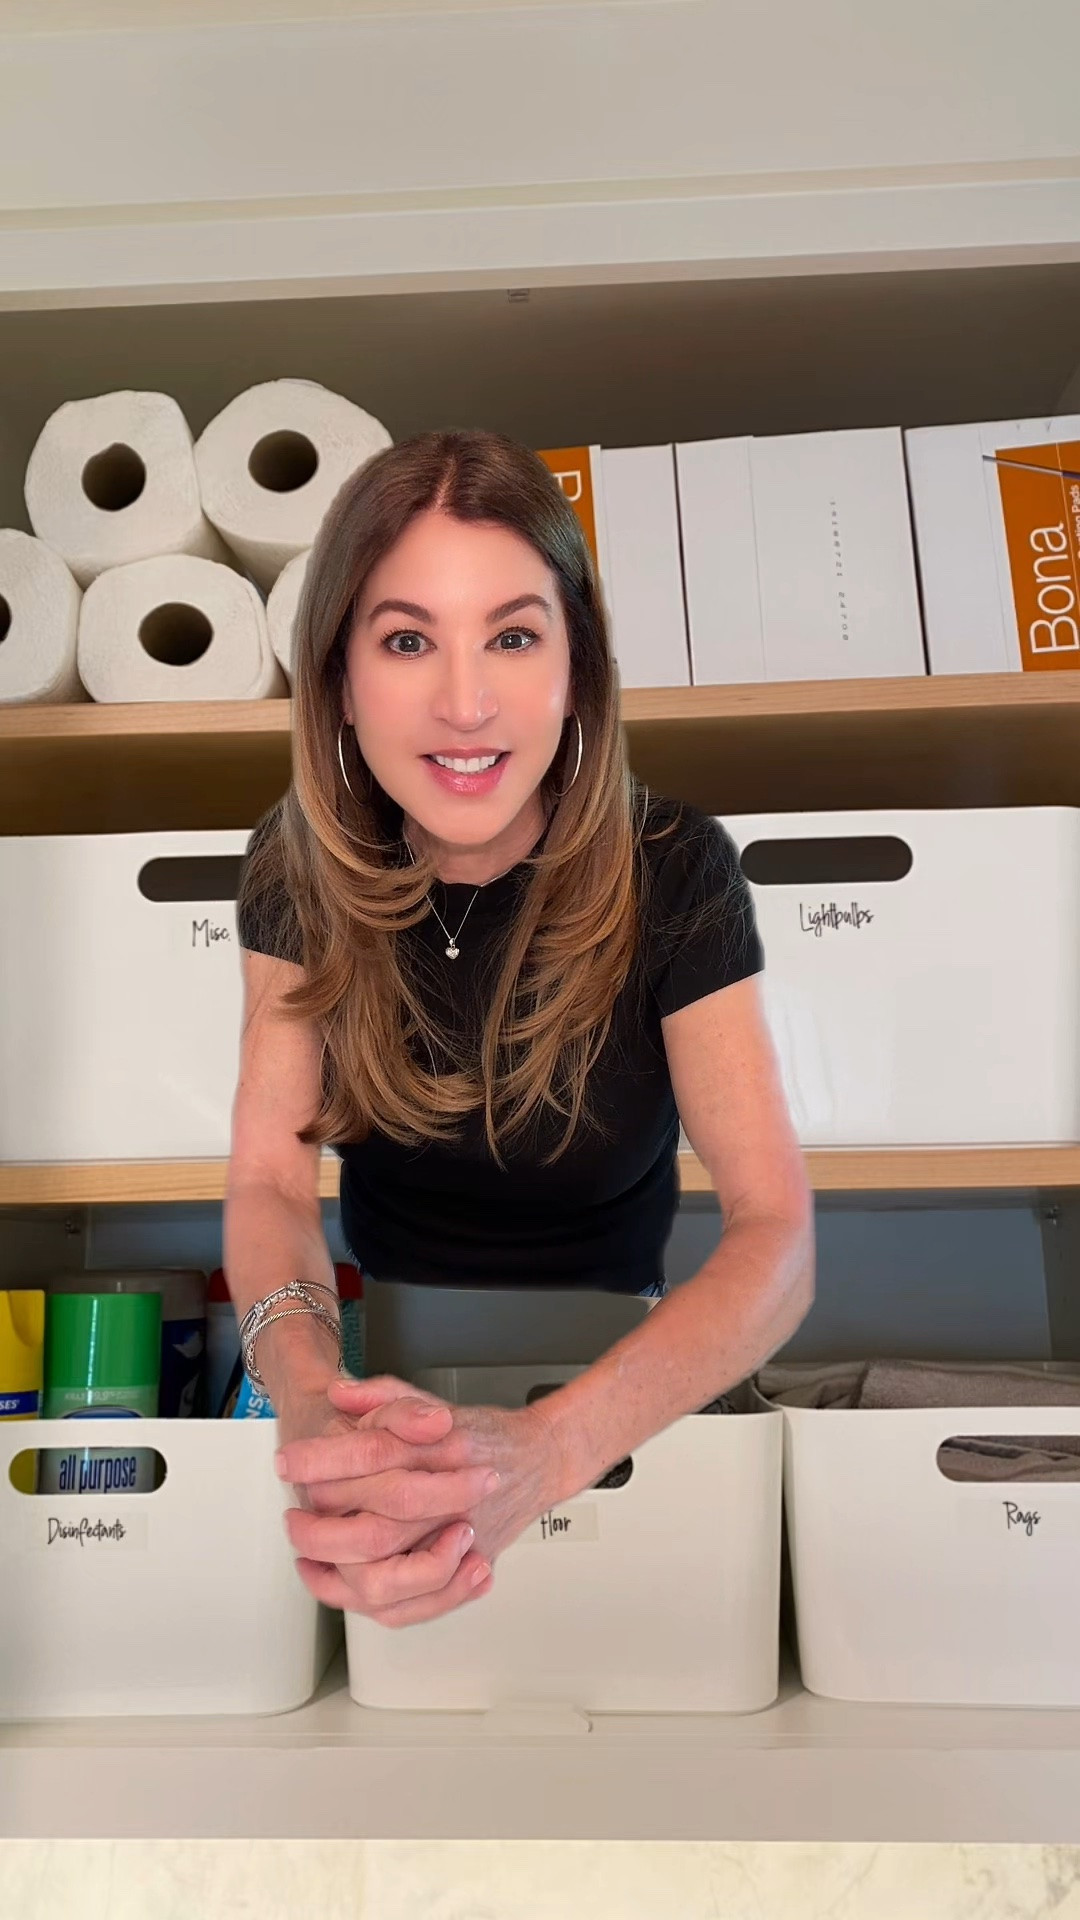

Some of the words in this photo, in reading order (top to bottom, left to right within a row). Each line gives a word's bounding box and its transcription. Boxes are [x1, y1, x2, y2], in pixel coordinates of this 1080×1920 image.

[1029, 521, 1080, 654] Bona
[799, 901, 874, 938] Lightbulbs
[59, 1453, 76, 1491] all
[78, 1456, 136, 1494] purpose
[47, 1516, 127, 1547] Disinfectants
[1002, 1500, 1041, 1537] Rags
